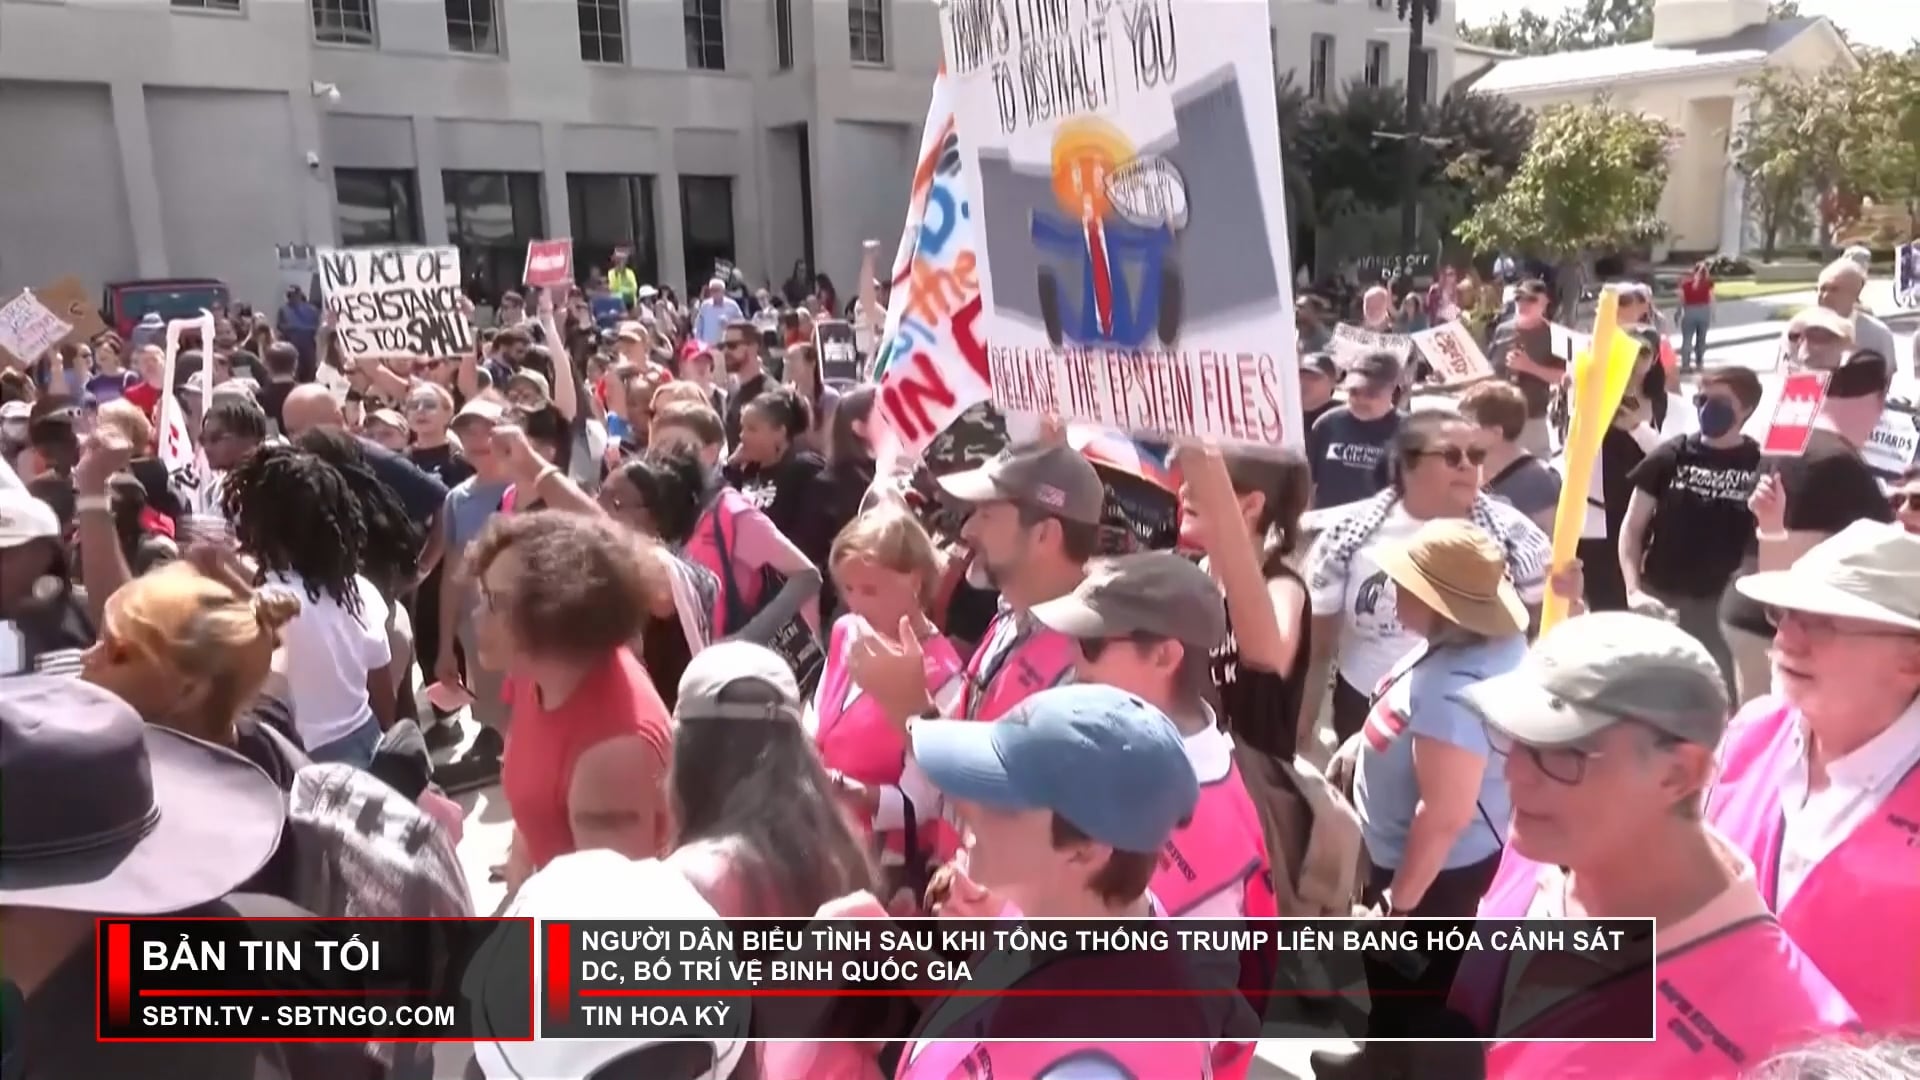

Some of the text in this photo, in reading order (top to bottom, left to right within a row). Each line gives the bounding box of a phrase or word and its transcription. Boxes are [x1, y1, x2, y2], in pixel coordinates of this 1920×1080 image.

[992, 61, 1017, 135] TO
[1020, 18, 1109, 128] DISTRACT
[1119, 0, 1178, 92] YOU
[320, 250, 452, 292] NO ACT OF
[339, 311, 474, 357] IS TOO SMALL
[991, 343, 1285, 447] RELEASE THE EPSTEIN FILES
